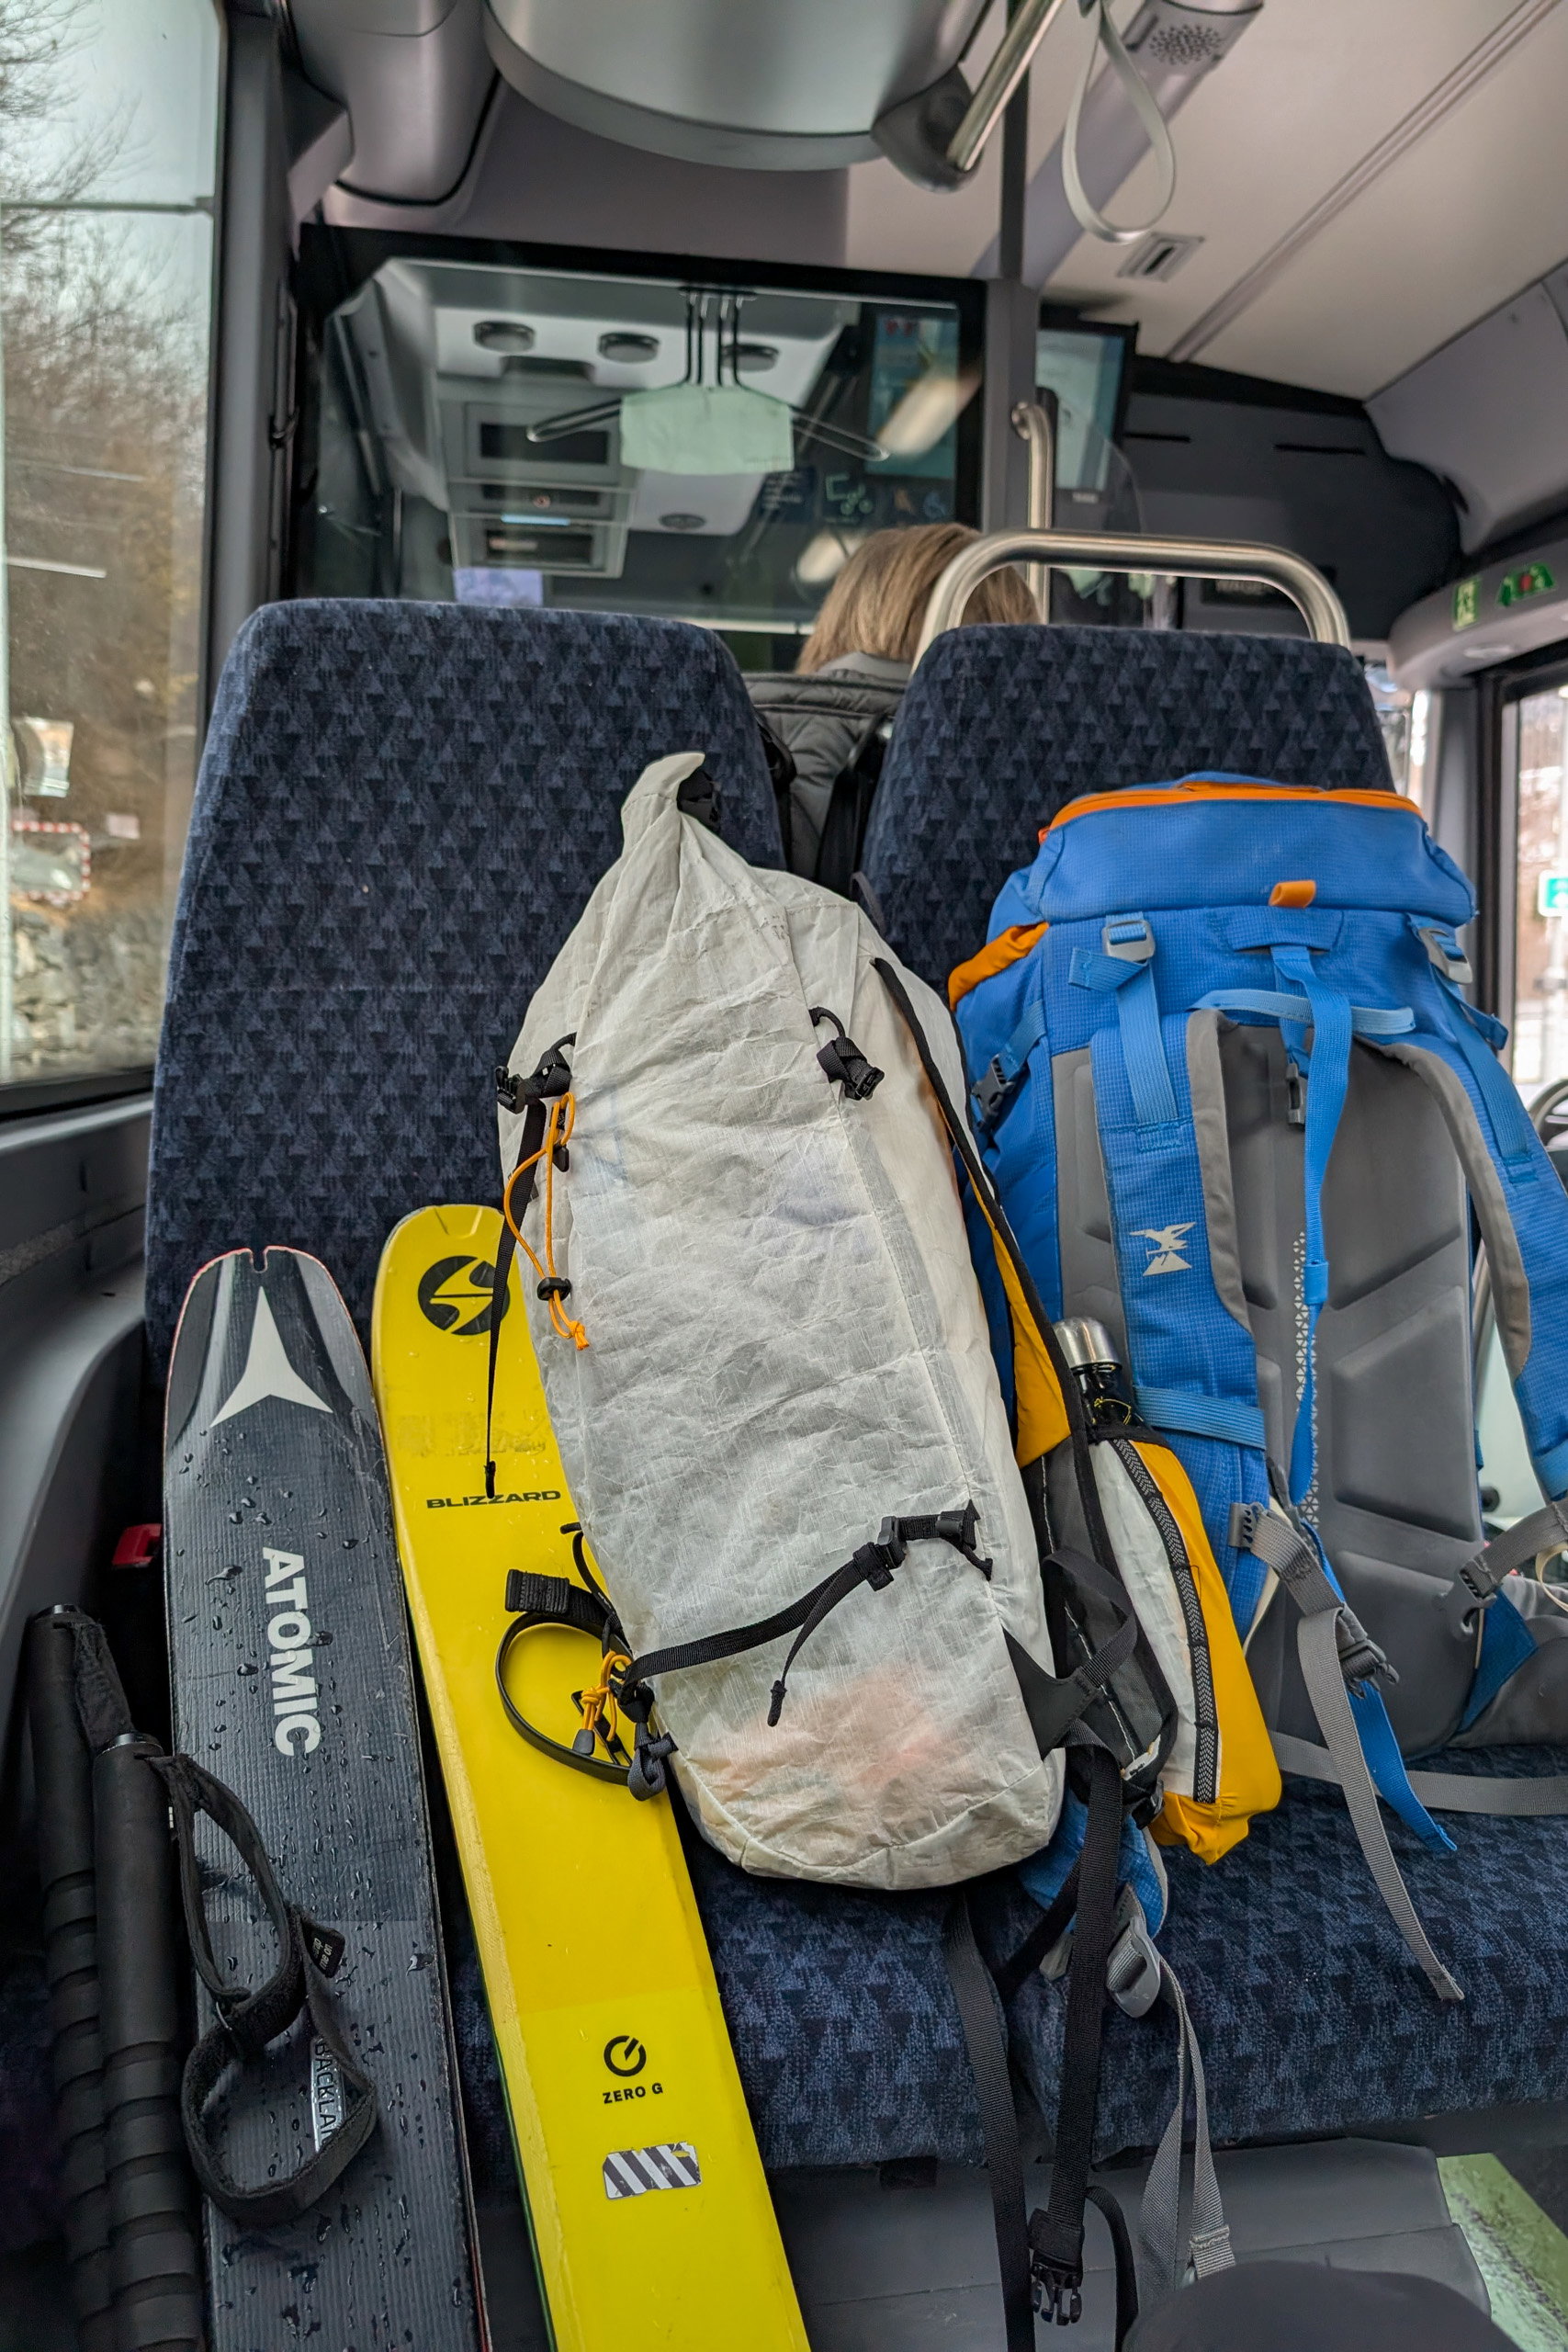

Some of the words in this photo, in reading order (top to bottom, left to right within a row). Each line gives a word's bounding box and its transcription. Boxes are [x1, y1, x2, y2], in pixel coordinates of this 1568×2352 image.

[426, 1490, 561, 1509] BLIZZARD
[263, 1547, 321, 1757] ATOMIC
[323, 1943, 333, 1956] on
[320, 1954, 329, 1970] me
[603, 2086, 646, 2104] ZERO
[651, 2082, 663, 2095] G
